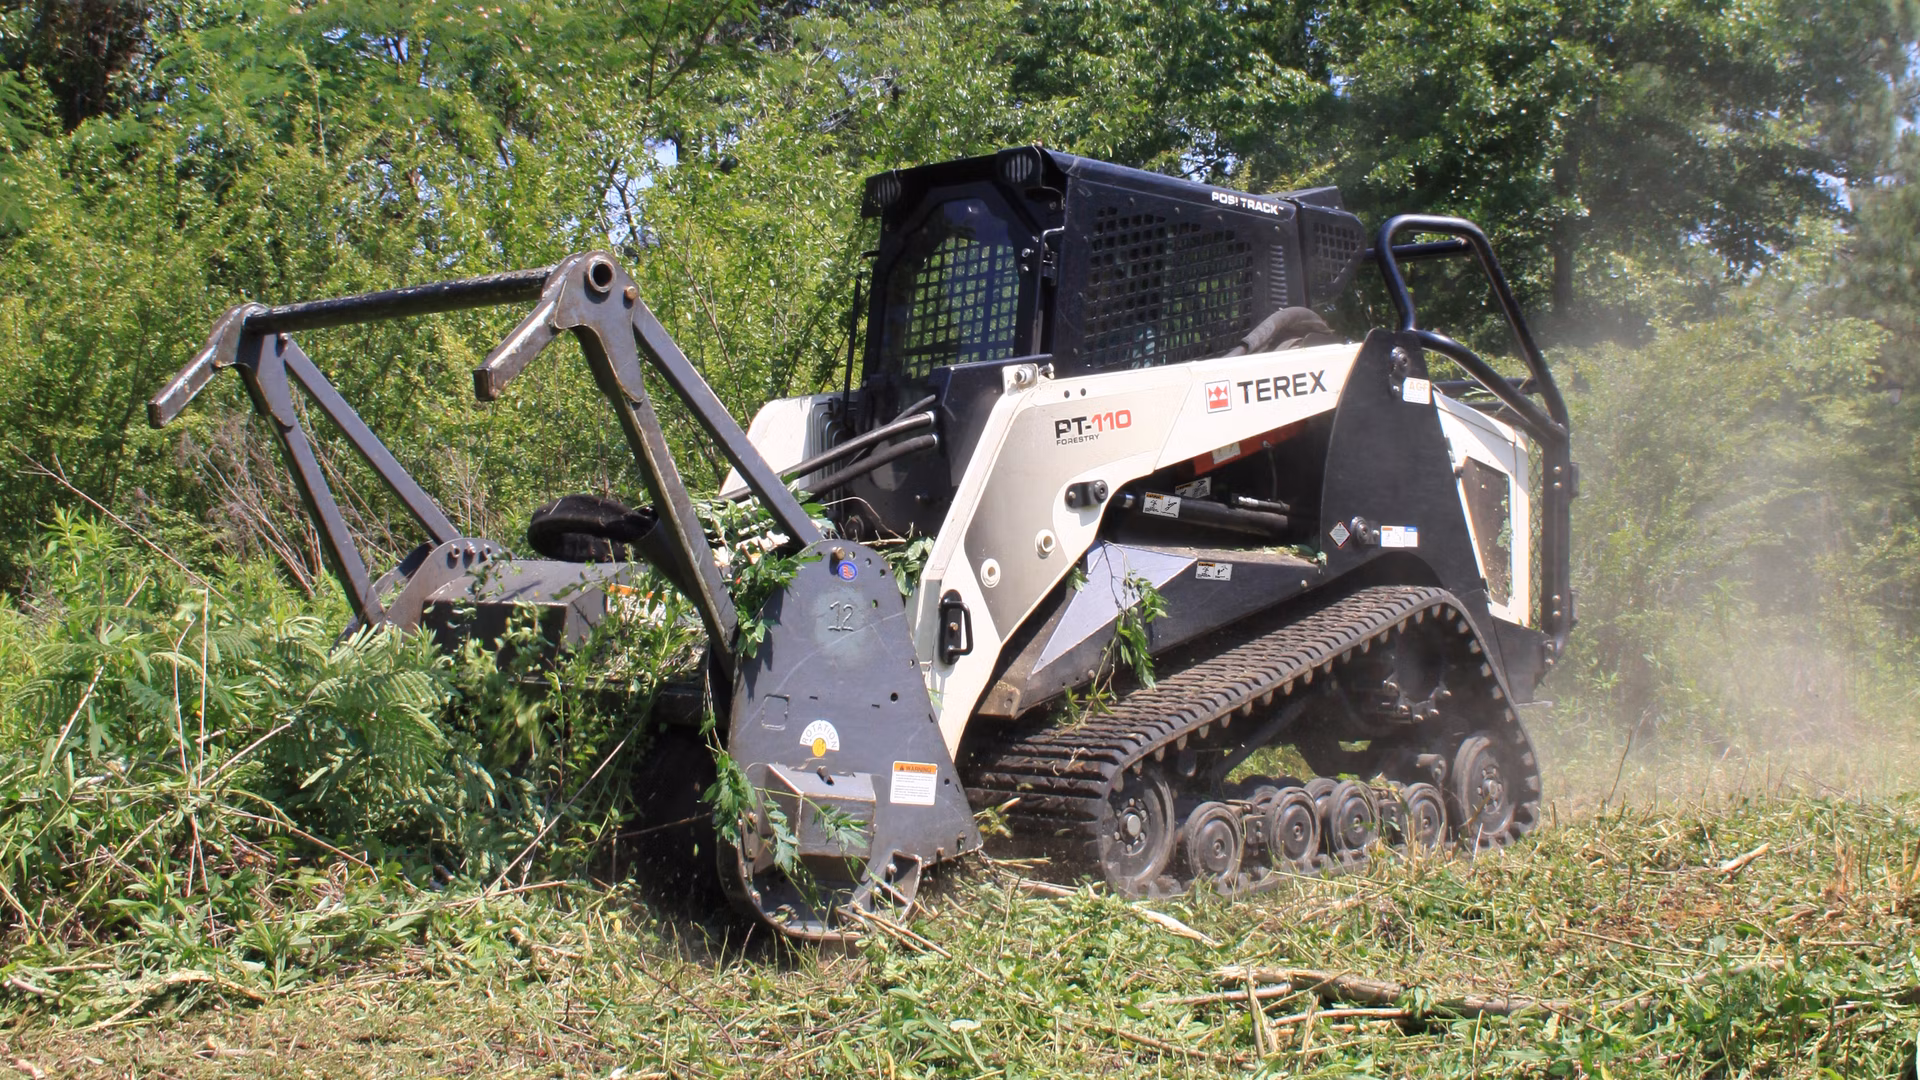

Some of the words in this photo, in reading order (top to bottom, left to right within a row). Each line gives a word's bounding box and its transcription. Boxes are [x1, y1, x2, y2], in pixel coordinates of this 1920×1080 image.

[1237, 369, 1327, 405] TEREX
[1054, 409, 1132, 439] PT-110
[1056, 433, 1100, 446] FORESTRY
[827, 600, 854, 632] 12
[801, 722, 838, 748] ROTATION
